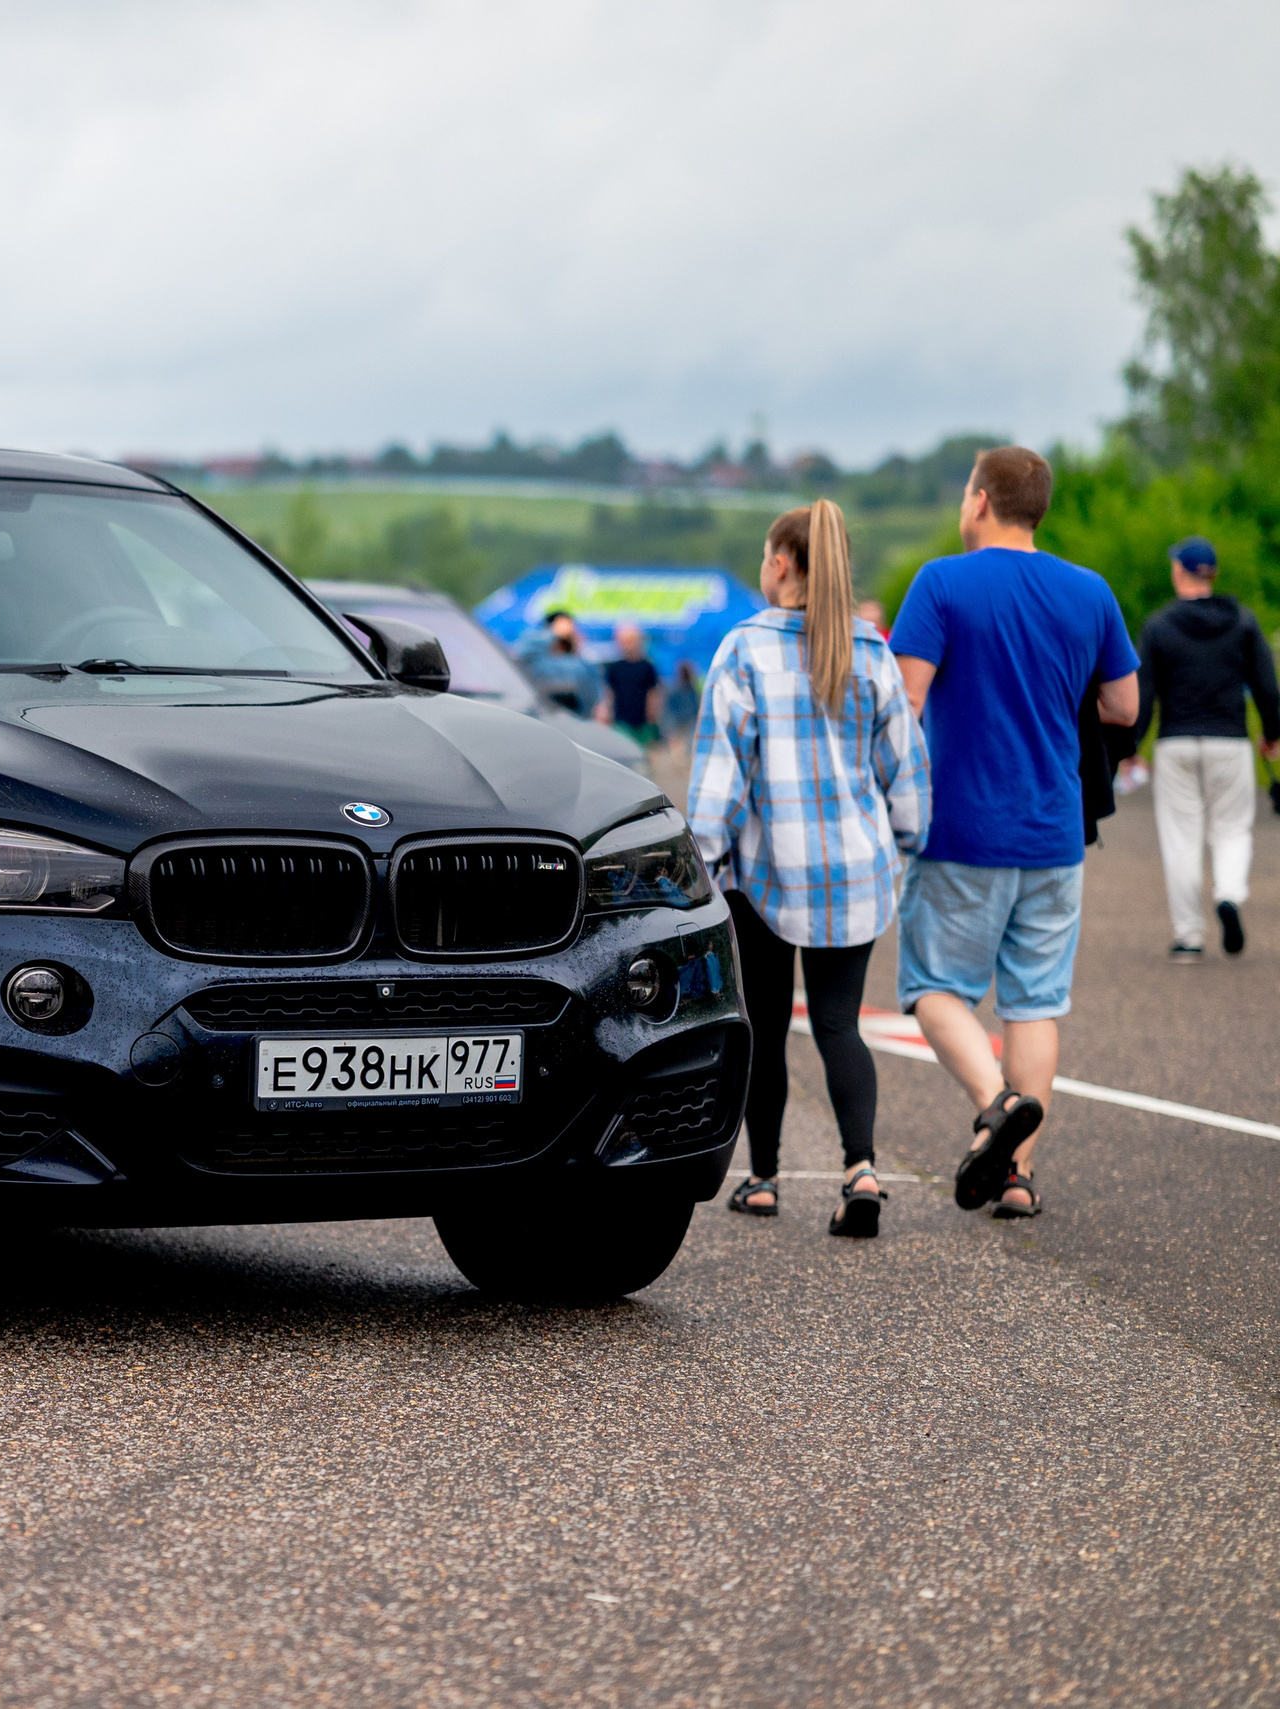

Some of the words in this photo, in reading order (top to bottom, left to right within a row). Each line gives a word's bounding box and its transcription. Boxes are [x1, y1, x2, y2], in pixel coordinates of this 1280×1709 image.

[450, 1038, 511, 1076] 977
[463, 1076, 494, 1090] RUS
[284, 1101, 323, 1109] ИТС-Авто
[347, 1099, 397, 1108] официальный
[398, 1099, 420, 1107] дилер
[421, 1097, 440, 1105] BMW
[462, 1095, 484, 1104] (3412)
